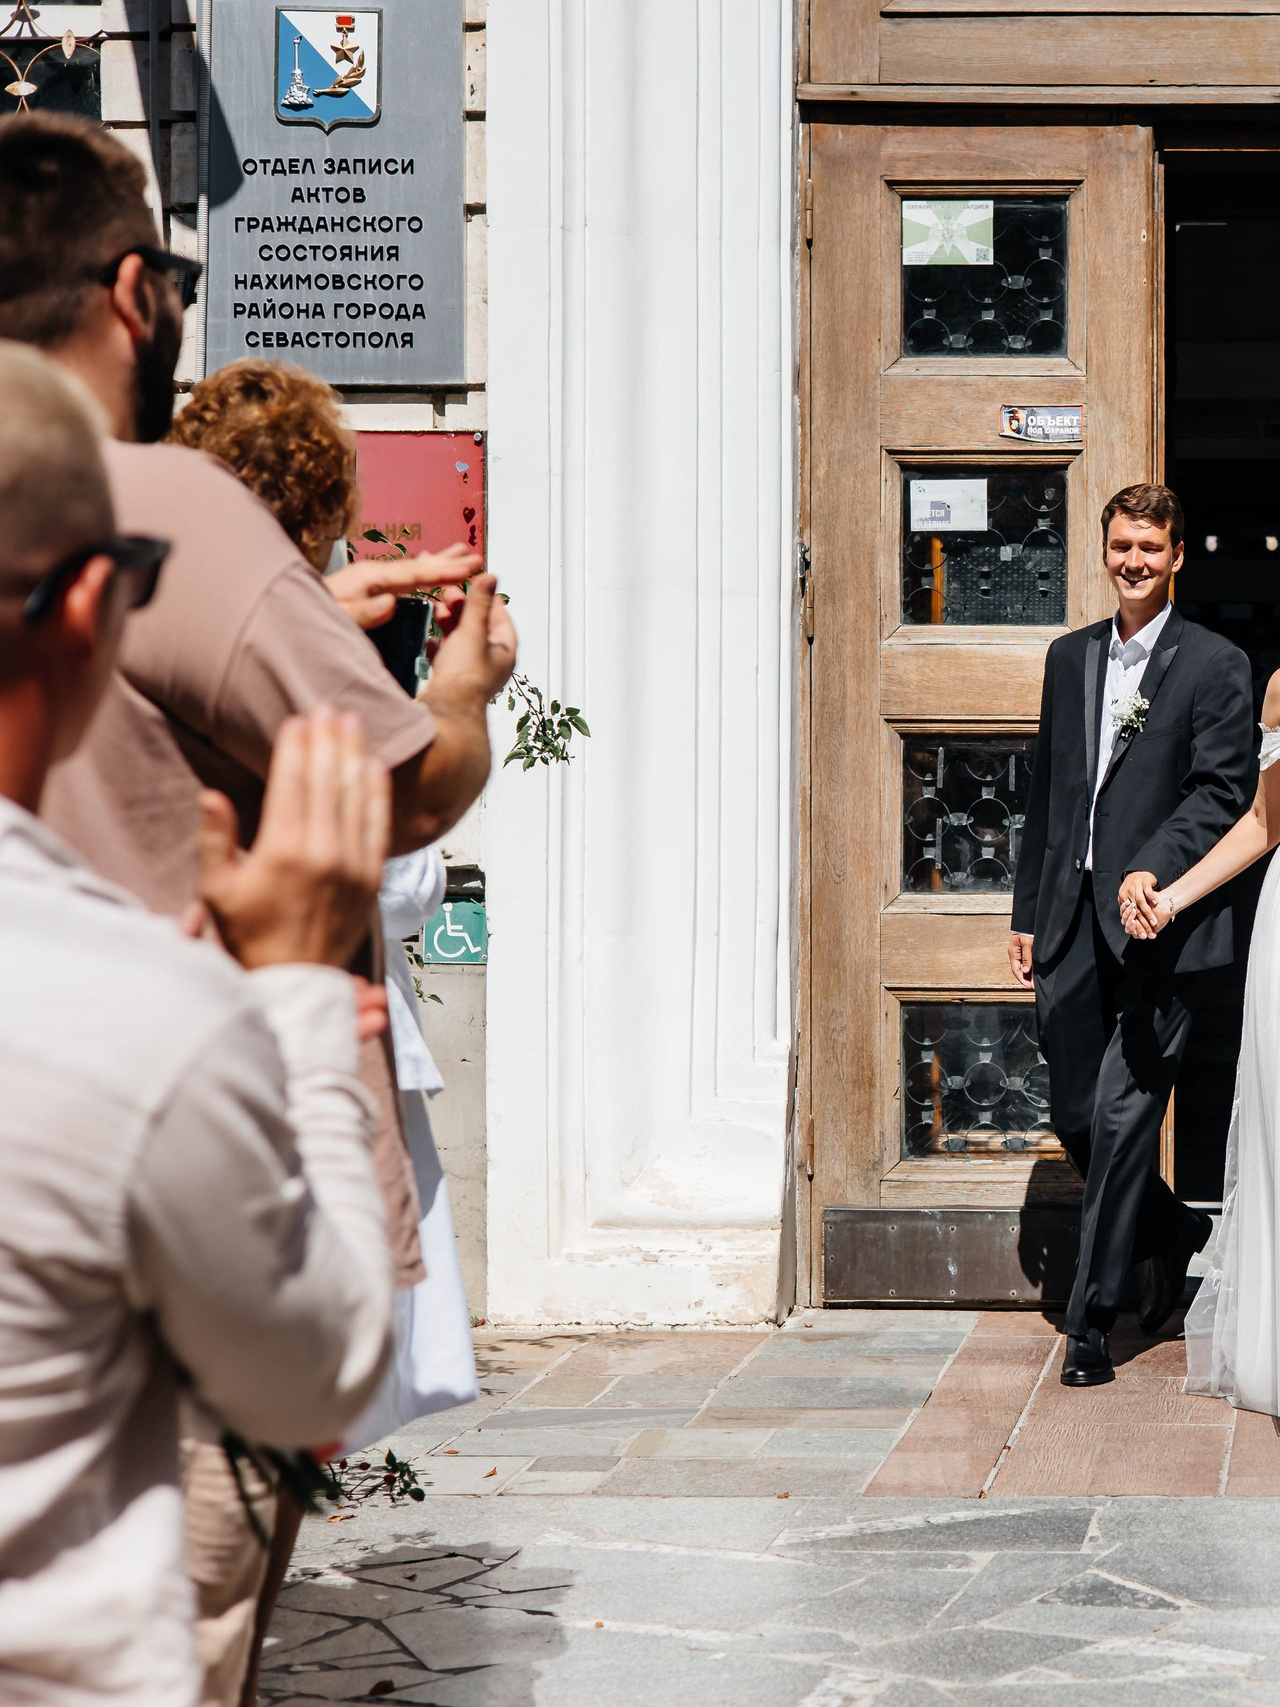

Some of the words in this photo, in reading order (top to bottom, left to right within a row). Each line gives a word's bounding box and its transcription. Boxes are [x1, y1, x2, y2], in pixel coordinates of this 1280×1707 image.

[242, 158, 316, 176] ОТДЕЛ
[323, 158, 414, 175] ЗАПИСИ
[291, 187, 367, 203] АКТОВ
[234, 216, 423, 234] ГРАЖДАНСКОГО
[259, 245, 399, 262] СОСТОЯНИЯ
[234, 273, 424, 291] НАХИМОВСКОГО
[233, 298, 325, 320] РАЙОНА
[333, 302, 426, 321] ГОРОДА
[245, 331, 414, 349] СЕВАСТОПОЛЯ
[1028, 416, 1079, 426] ОБЪЕКТ
